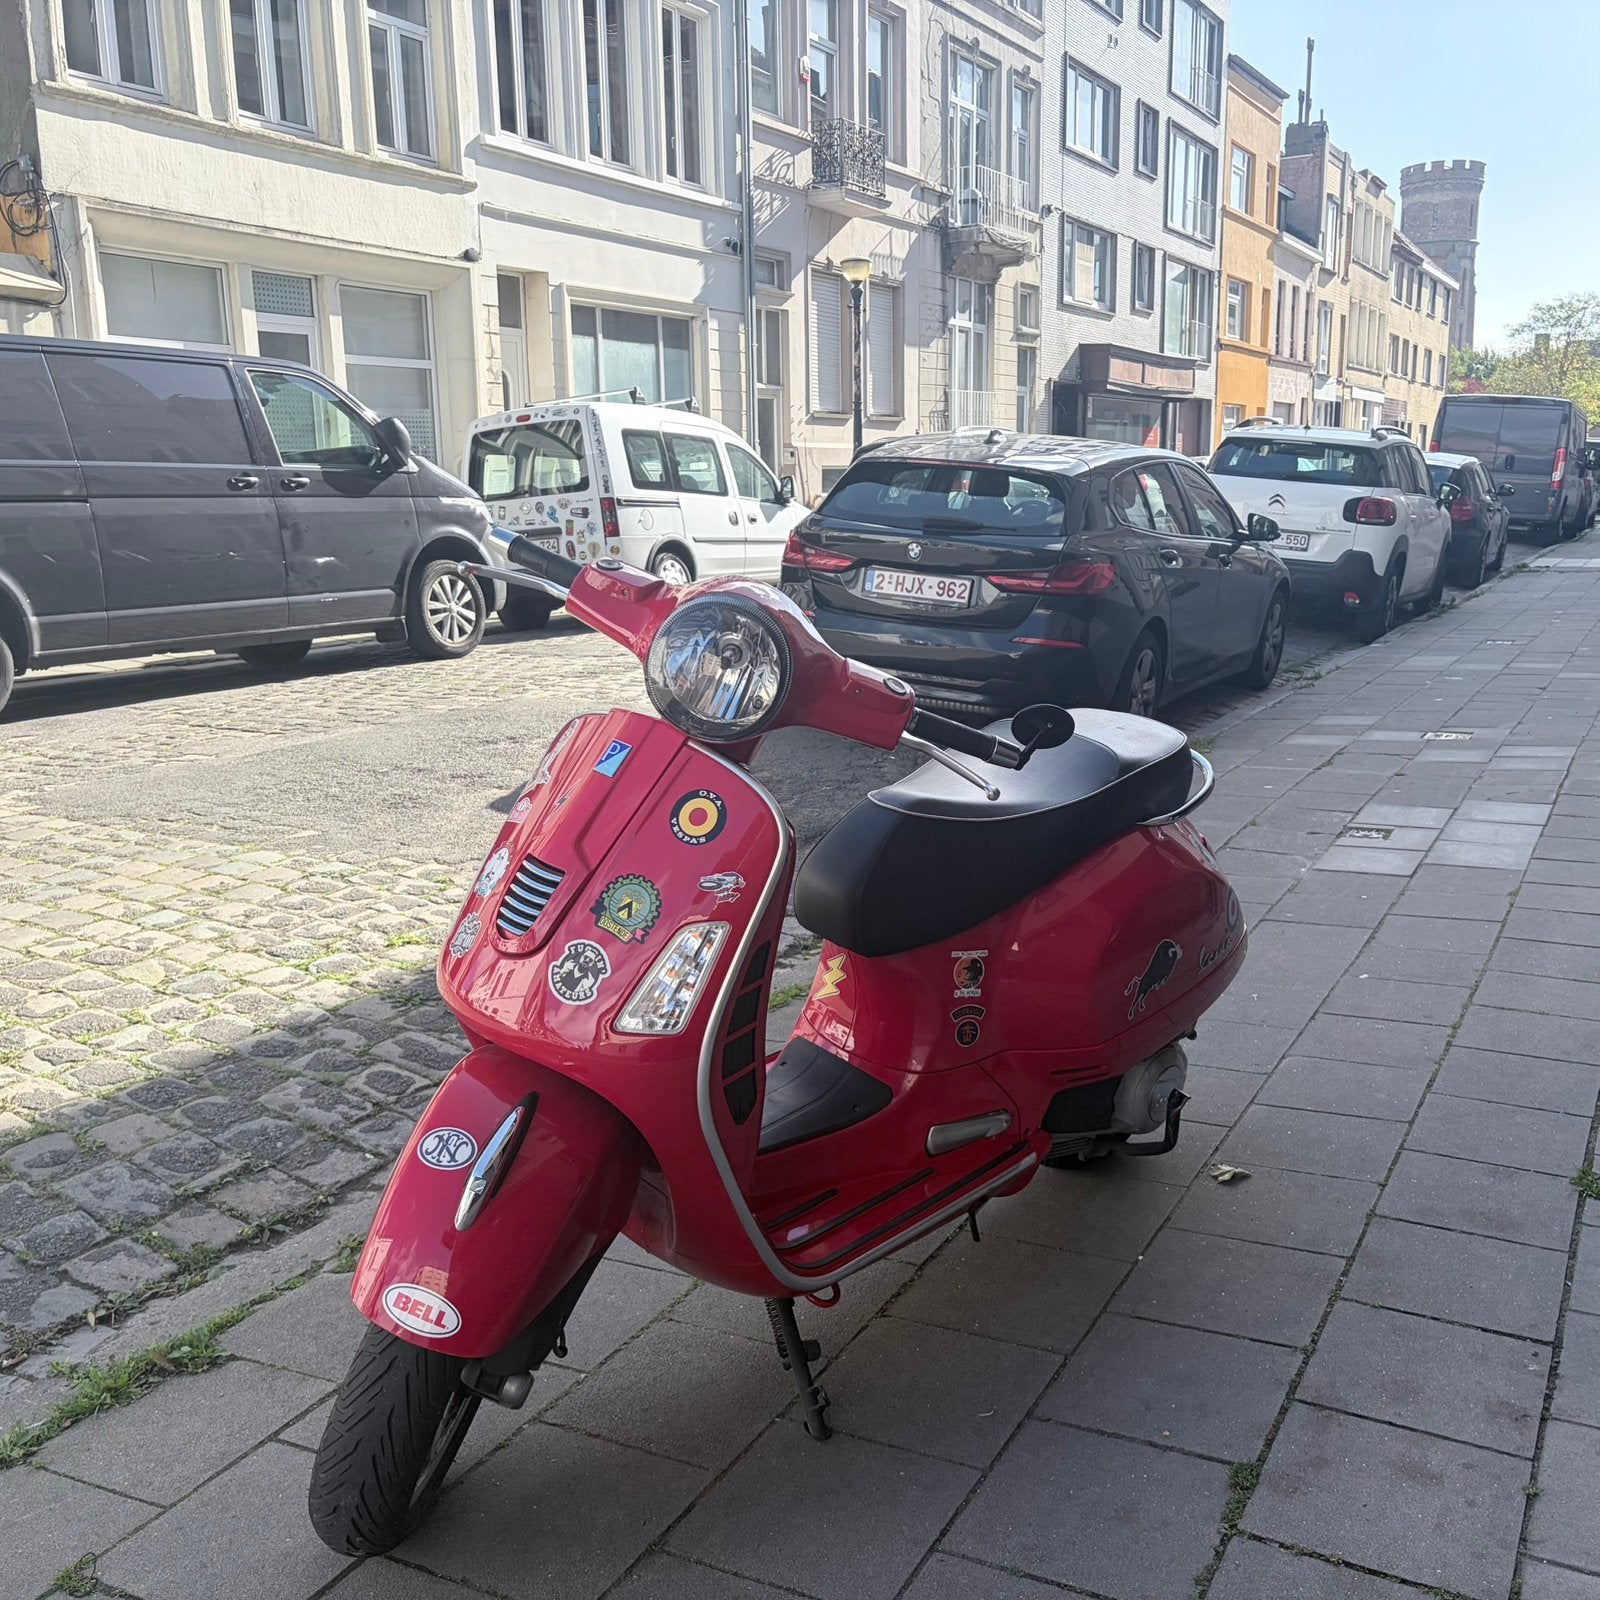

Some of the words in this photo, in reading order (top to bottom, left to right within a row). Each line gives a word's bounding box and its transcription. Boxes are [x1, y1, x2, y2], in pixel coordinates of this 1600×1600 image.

[874, 573, 968, 600] 2-HJX-962
[553, 966, 592, 999] AMATEURS
[393, 1292, 447, 1330] BELL
